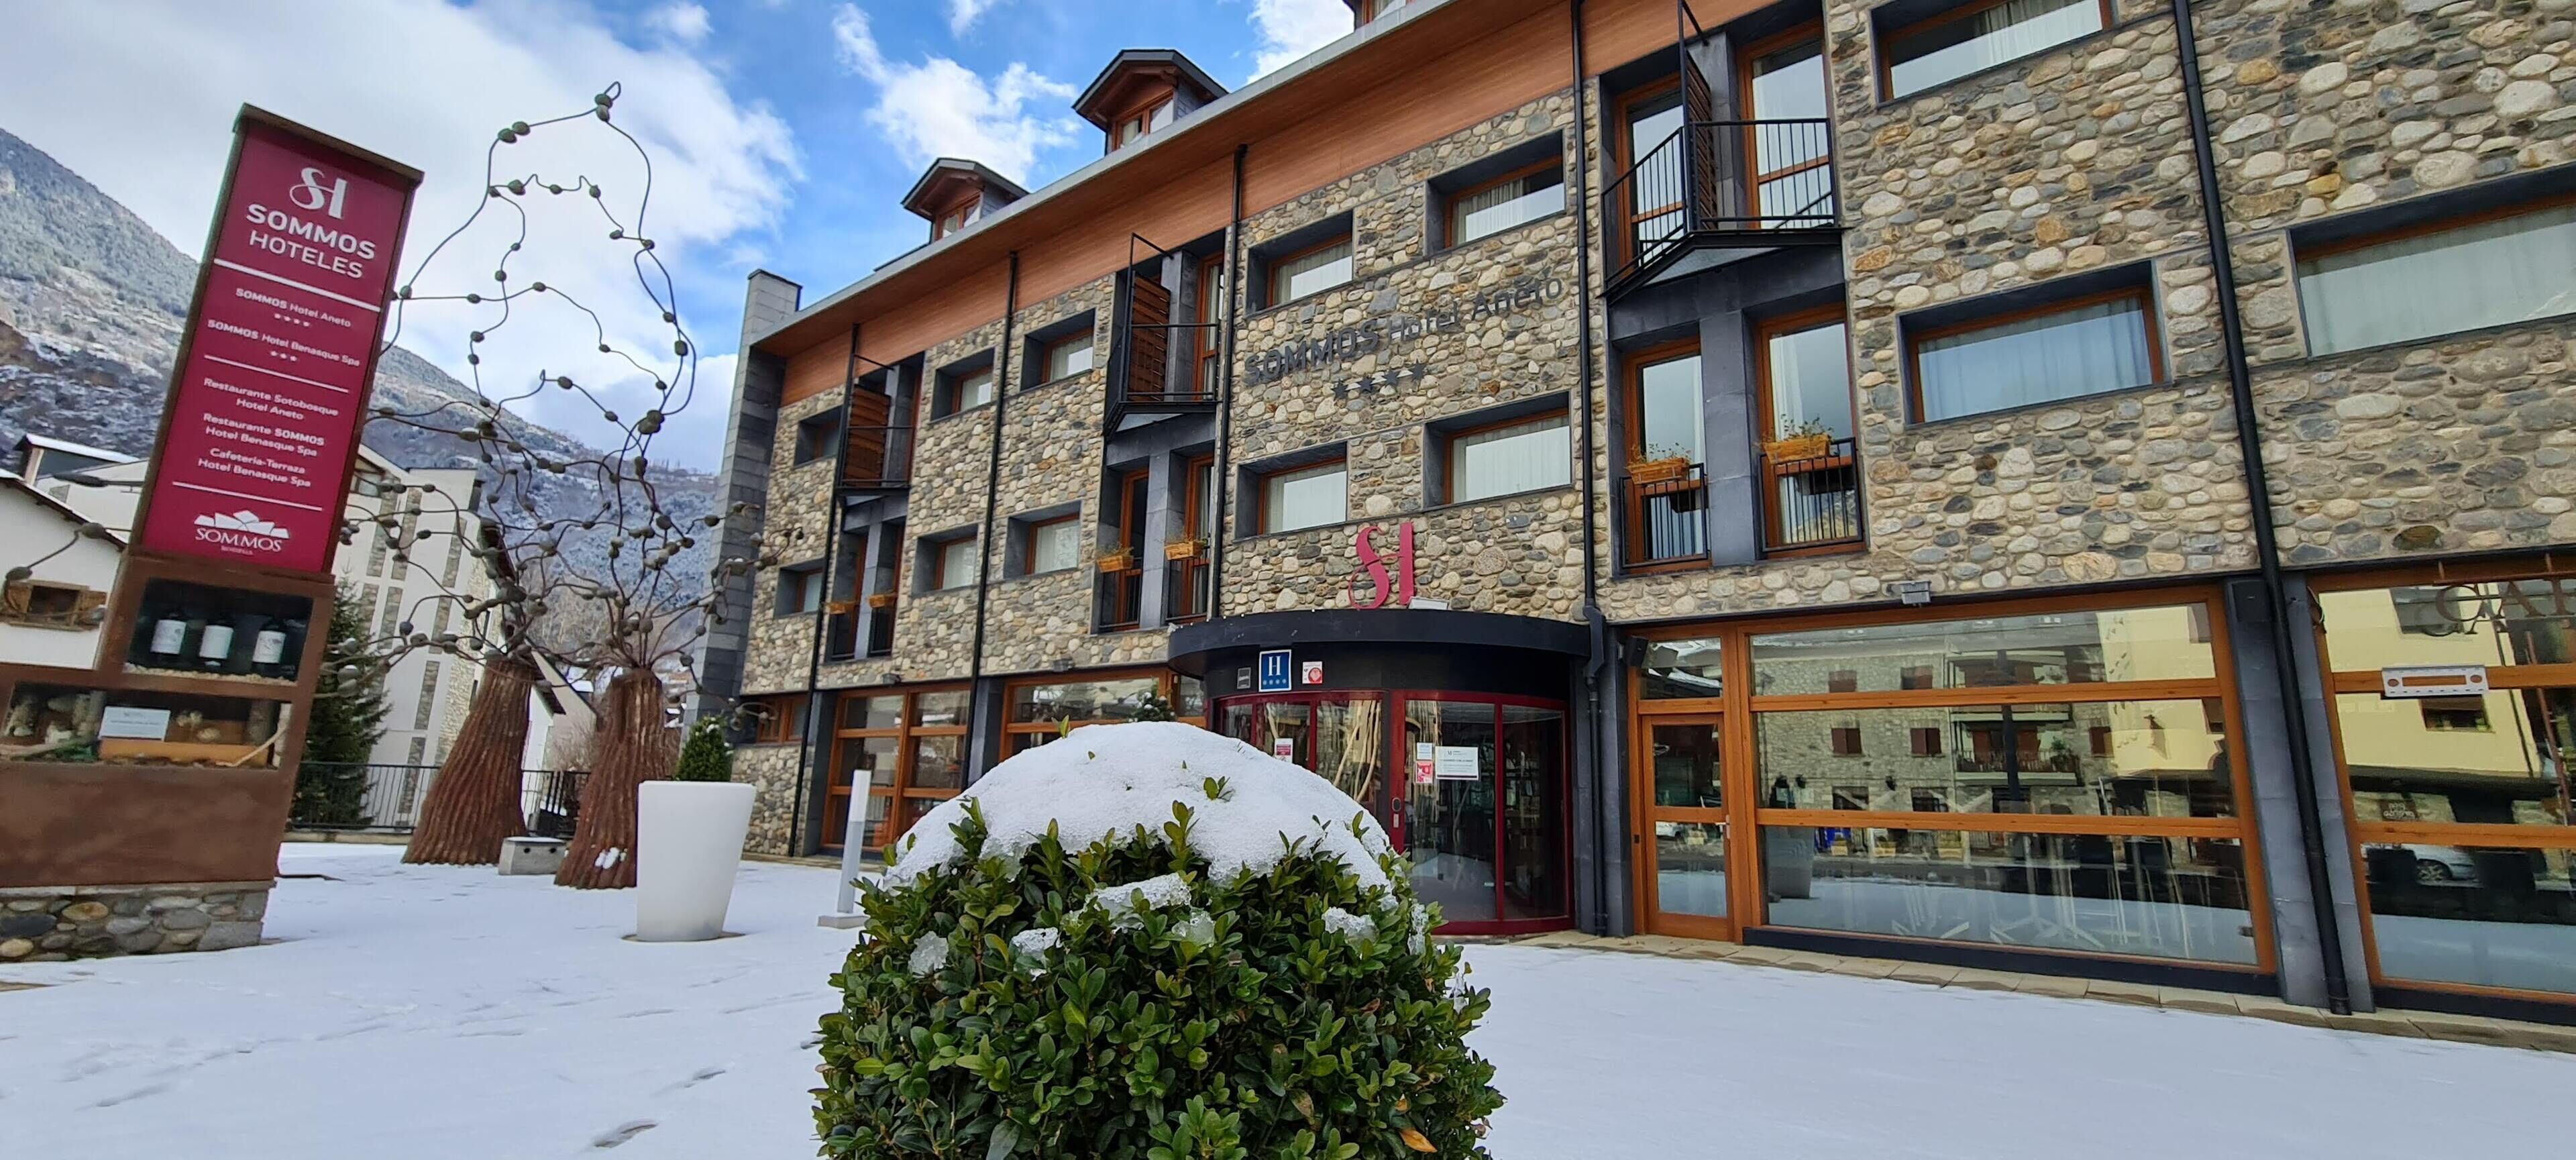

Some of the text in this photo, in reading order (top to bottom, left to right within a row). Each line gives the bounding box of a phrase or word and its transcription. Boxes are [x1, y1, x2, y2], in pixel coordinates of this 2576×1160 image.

[246, 203, 376, 260] SOMMOS
[250, 229, 363, 278] HOTELES
[235, 288, 352, 327] SOMMOS Hotel Aneto
[207, 319, 360, 367] SOMMOS Hotel Benasque Spa
[1244, 276, 1563, 386] SOMMOS Hotel Aneto
[203, 378, 339, 416] Restaurante Sotobosque
[236, 398, 304, 420] Hotel Aneto
[203, 413, 325, 446] Restaurante SOMMOS
[205, 425, 317, 457] Hotel Benasque Spa
[198, 458, 311, 487] Hotel Benasque Spa
[195, 528, 282, 552] SOMMOS
[1268, 655, 1281, 676] H
